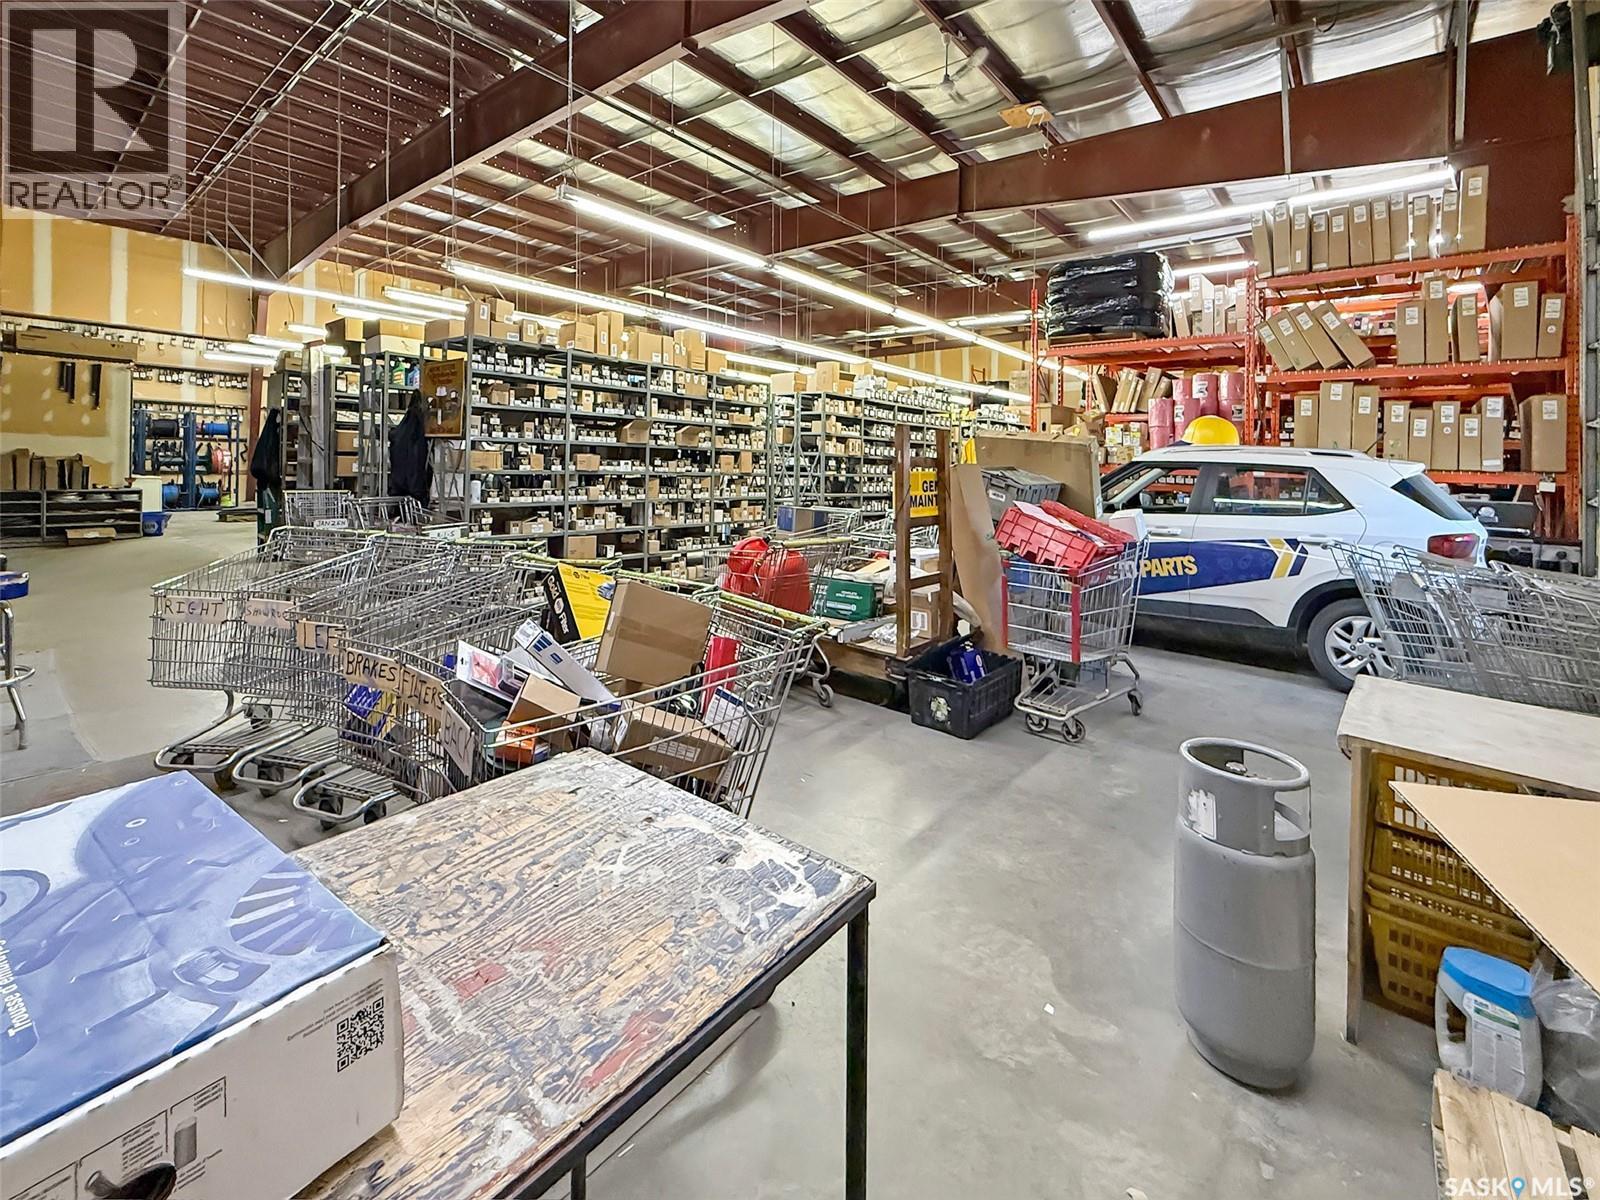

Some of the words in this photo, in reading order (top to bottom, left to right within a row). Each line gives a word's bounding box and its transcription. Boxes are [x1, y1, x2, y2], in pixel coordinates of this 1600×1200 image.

[1140, 555, 1198, 578] PARTS
[164, 599, 223, 617] RIGHT
[303, 622, 346, 650] LEF
[346, 651, 398, 682] BRAKES
[402, 669, 445, 710] FILTERS
[5, 992, 33, 1037] Trousse
